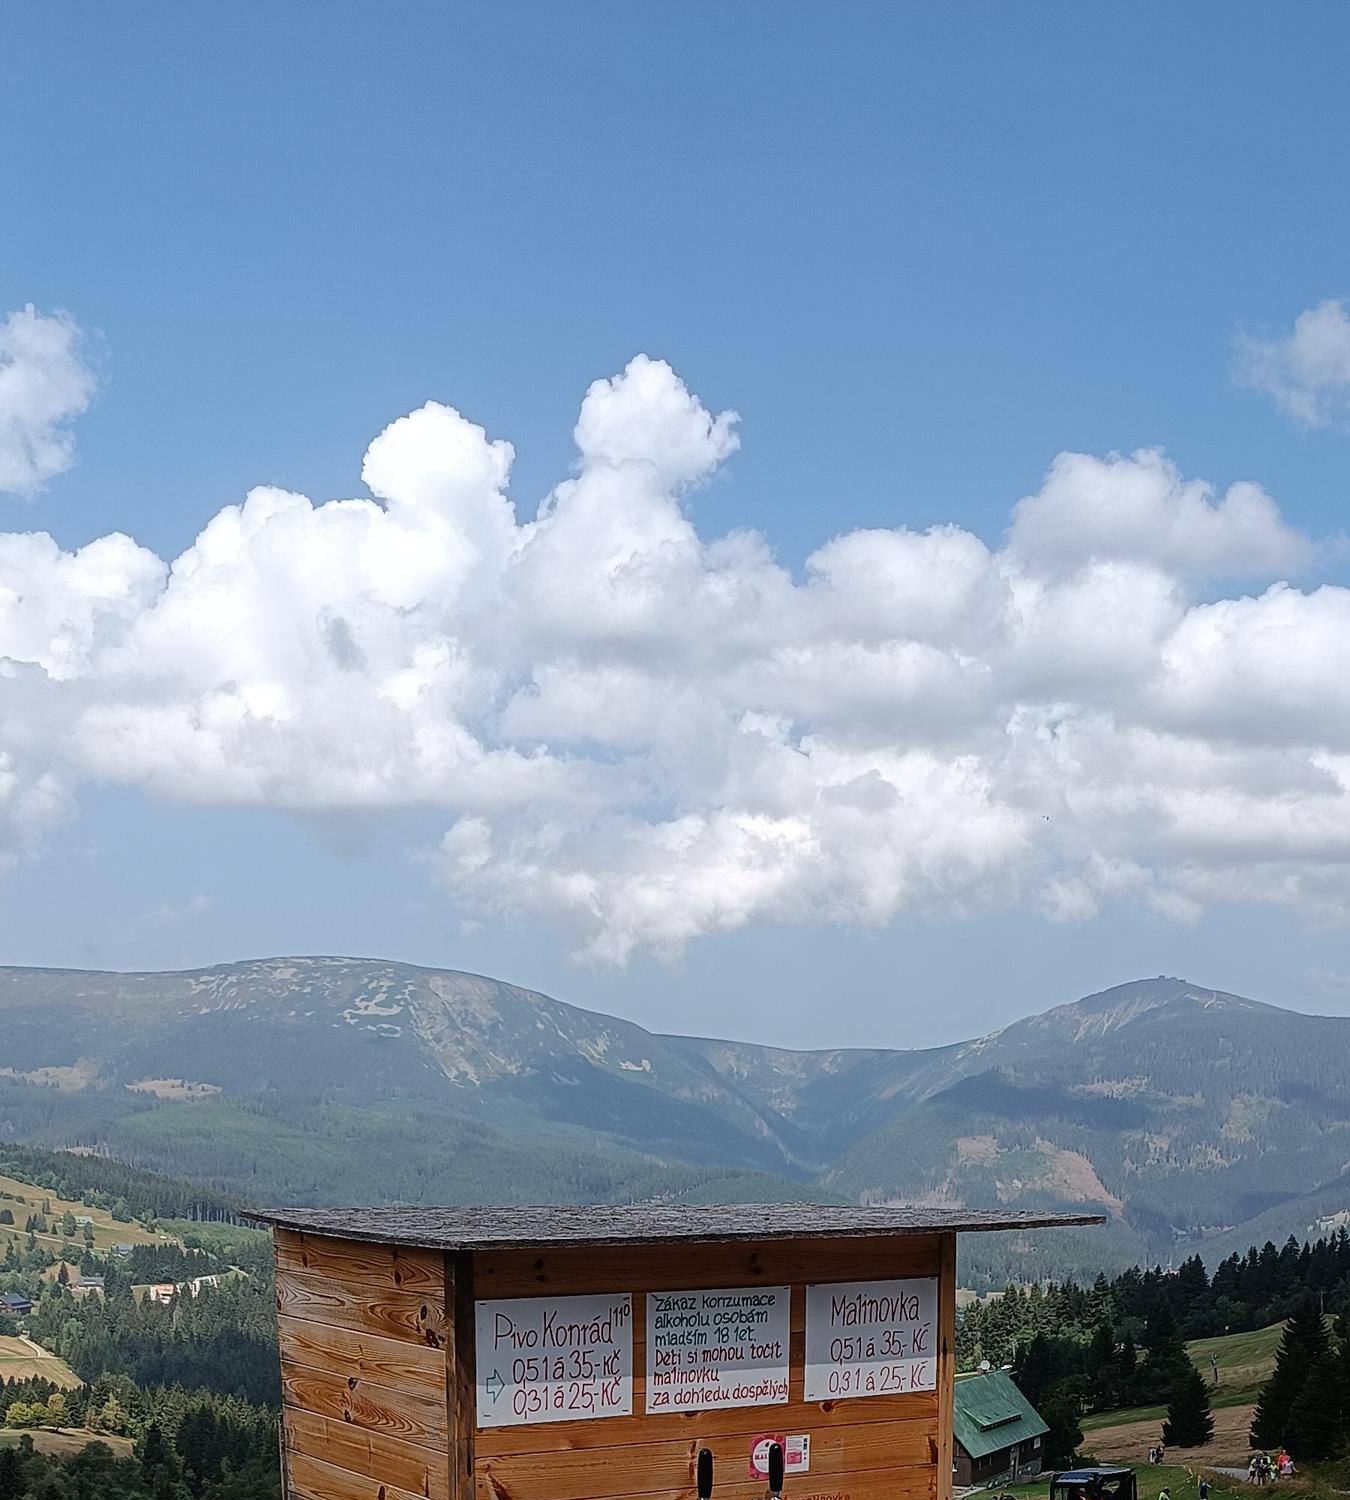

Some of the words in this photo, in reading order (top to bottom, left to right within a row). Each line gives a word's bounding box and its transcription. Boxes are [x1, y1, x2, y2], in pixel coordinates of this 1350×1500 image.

[702, 1294, 776, 1309] konzumace
[831, 1291, 920, 1327] Malinovka
[494, 1313, 538, 1350] Pivo
[542, 1307, 613, 1348] Konrád
[655, 1311, 710, 1329] alkoholu
[713, 1308, 768, 1325] osobám
[714, 1326, 729, 1344] 18
[687, 1348, 698, 1364] si
[702, 1346, 744, 1362] mohou
[653, 1366, 720, 1386] malinovku
[653, 1392, 670, 1406] za
[674, 1385, 730, 1405] dohledu
[732, 1378, 788, 1401] dospělých
